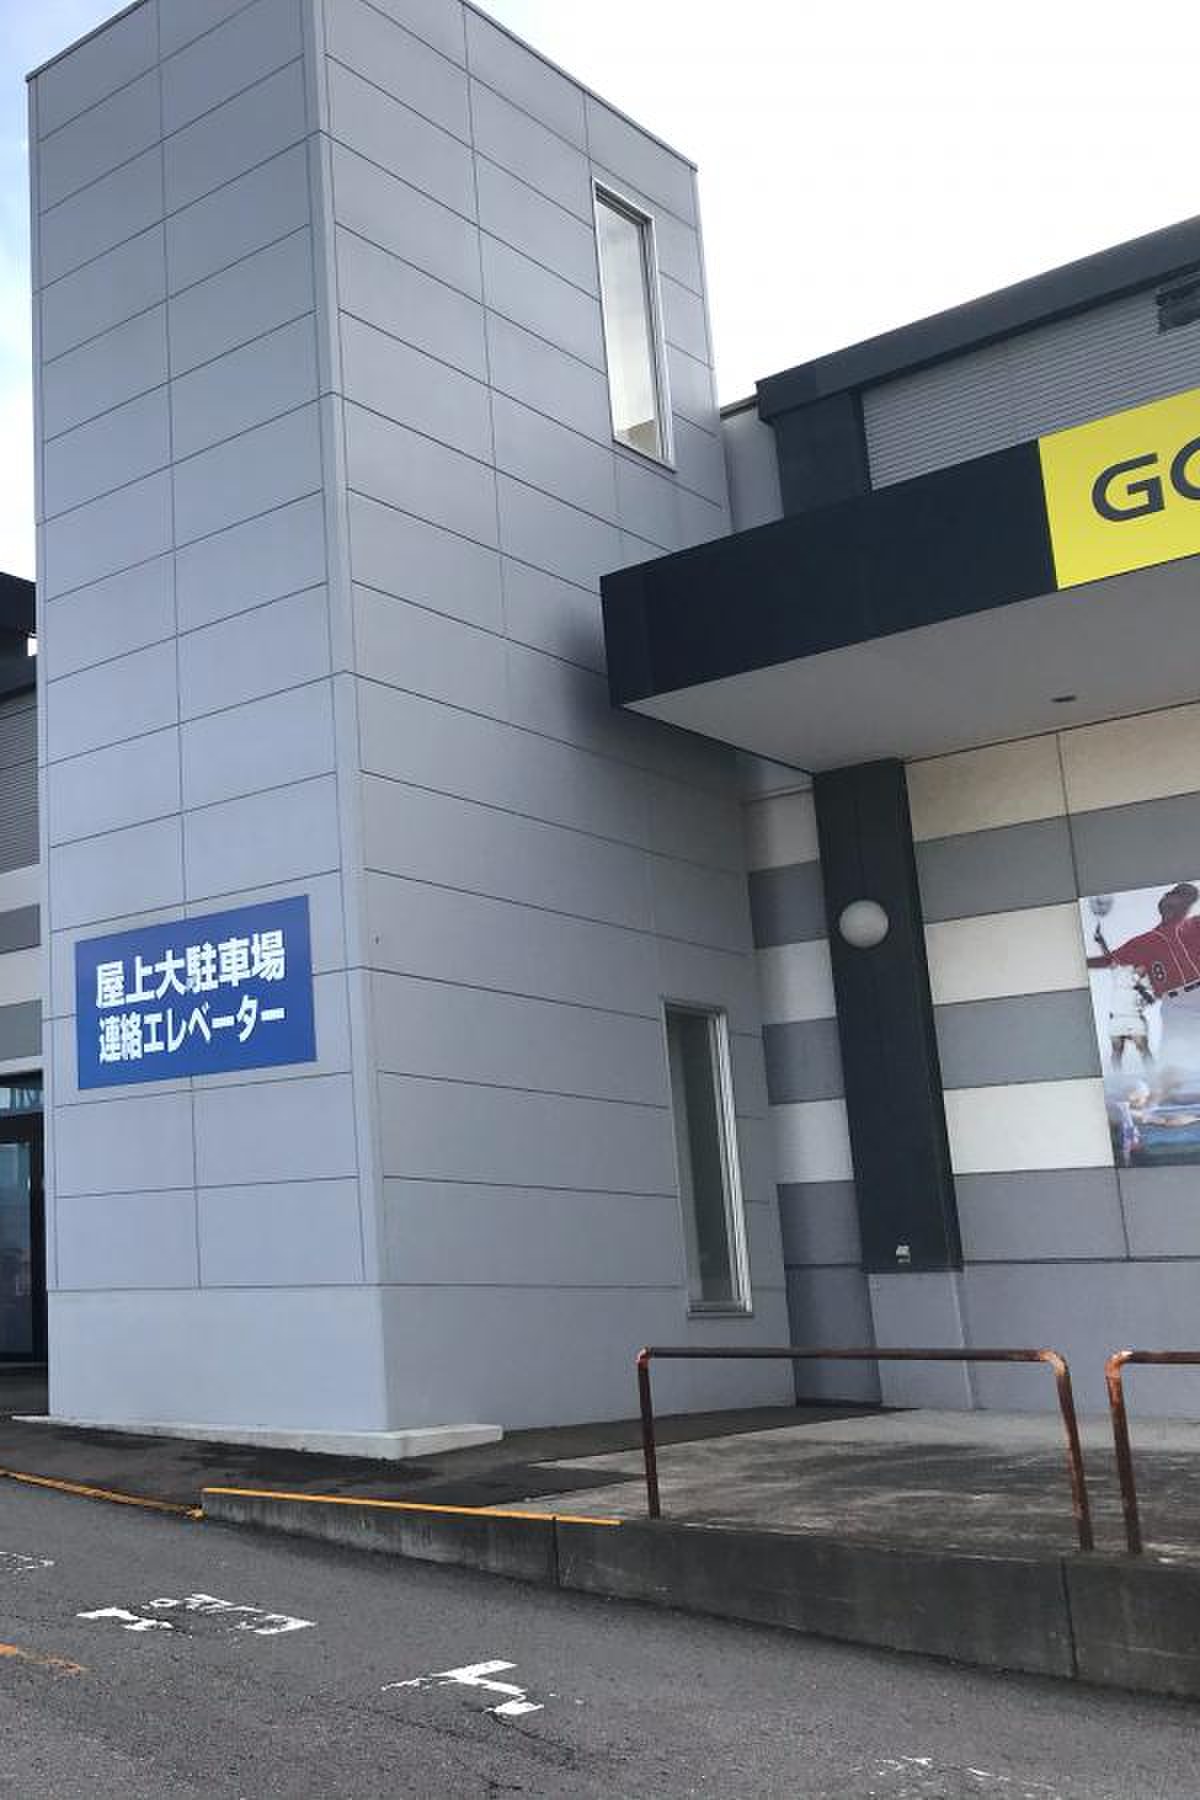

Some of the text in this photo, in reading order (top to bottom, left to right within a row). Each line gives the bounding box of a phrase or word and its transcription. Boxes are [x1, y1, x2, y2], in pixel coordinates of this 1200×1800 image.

[96, 930, 285, 1009] 屋上大駐車場
[99, 995, 285, 1063] 連絡エレベーター
